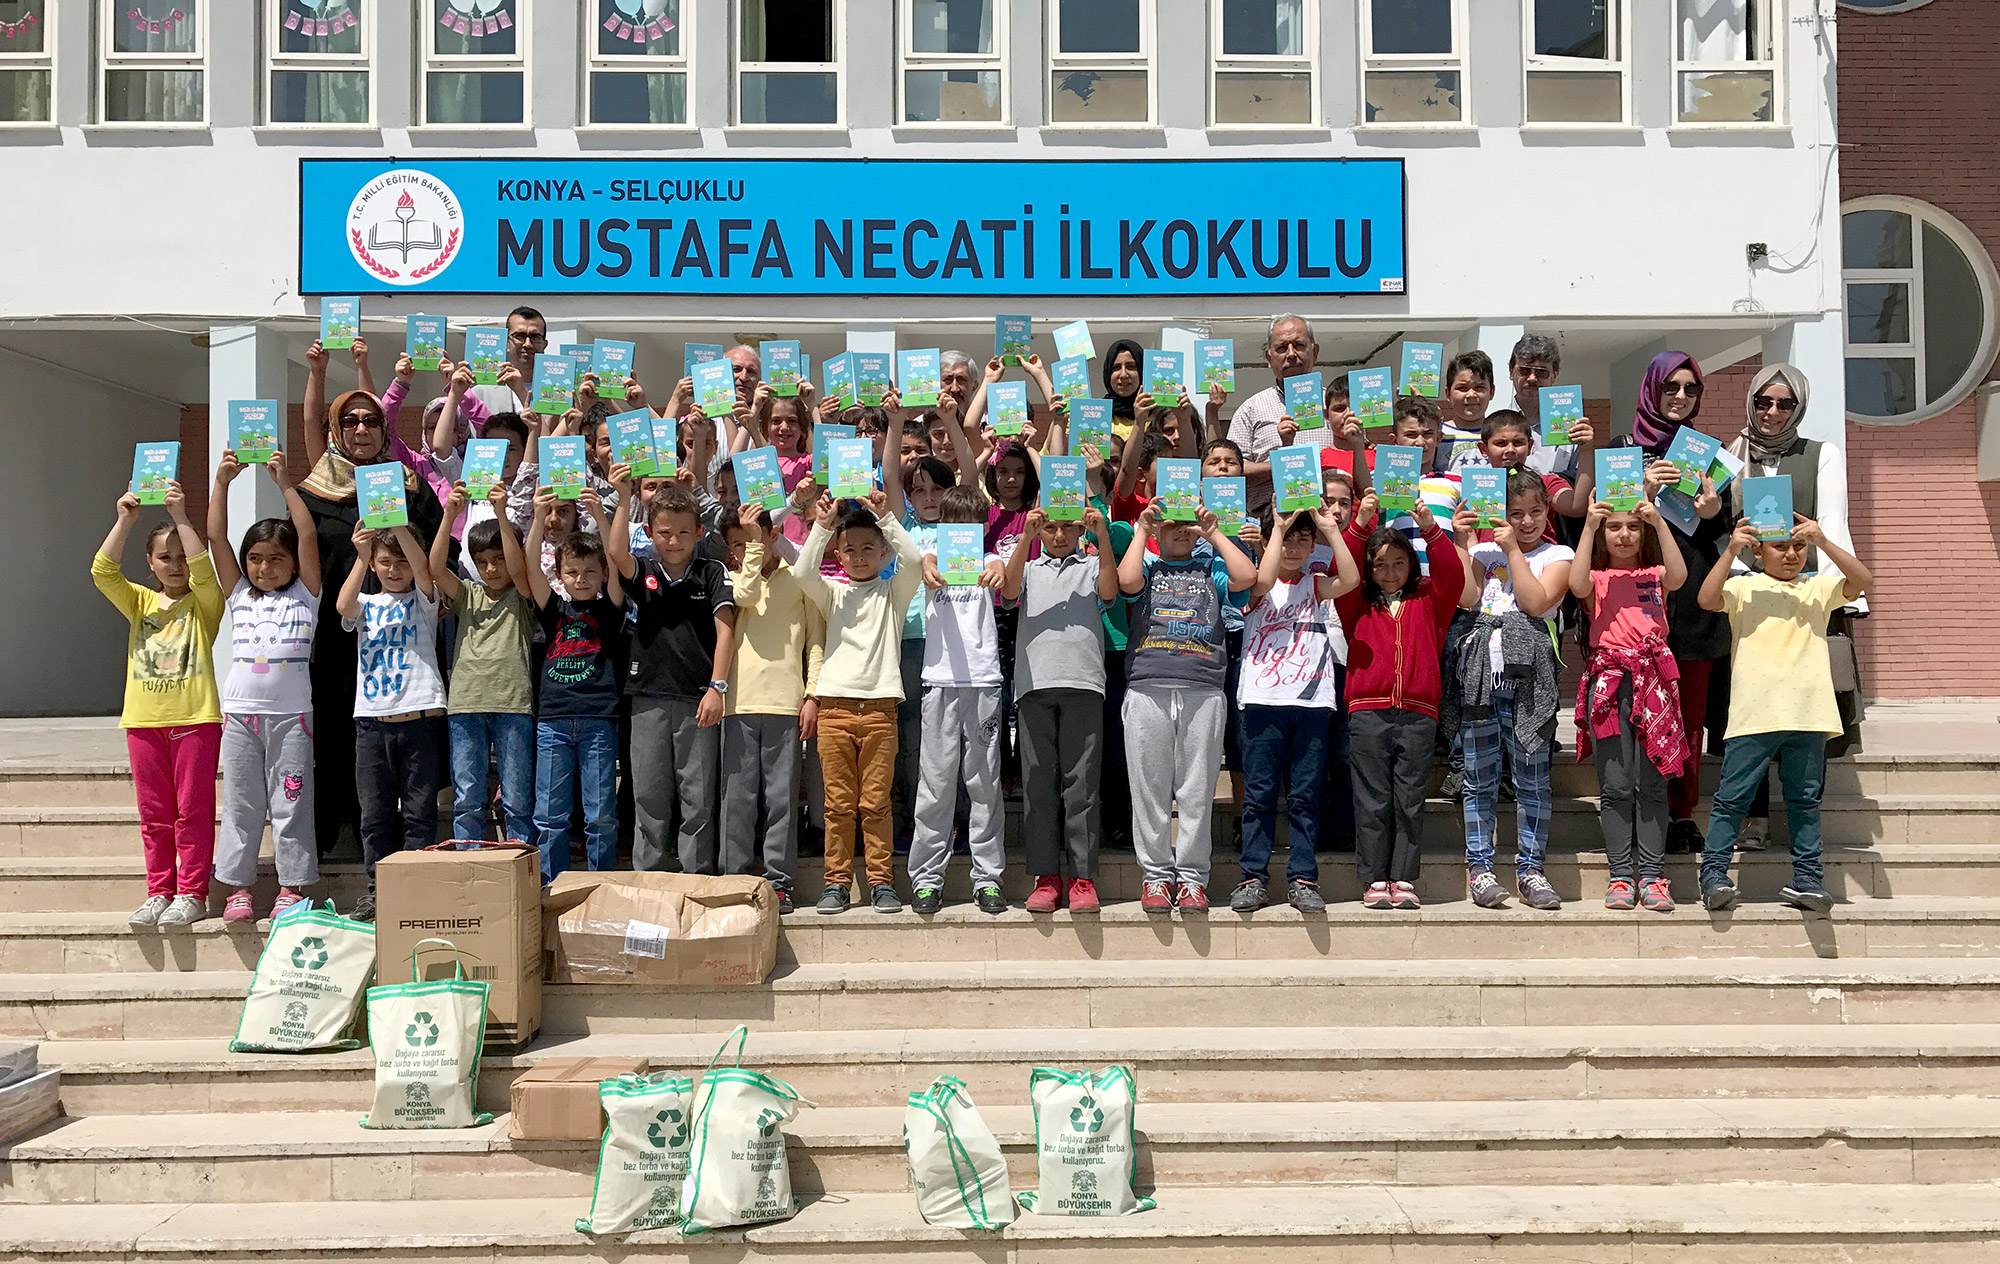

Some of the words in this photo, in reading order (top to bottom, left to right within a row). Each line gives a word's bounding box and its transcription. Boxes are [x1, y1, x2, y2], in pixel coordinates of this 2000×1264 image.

[352, 203, 366, 220] T.C.
[362, 179, 385, 202] MİLLİ
[386, 174, 419, 186] EĞİTİM
[420, 178, 457, 220] BAKANLIĞI
[498, 179, 586, 201] KONYA
[610, 179, 744, 205] SELÇUKLU
[497, 217, 794, 278] MUSTAFA
[814, 204, 1034, 280] NECATİ
[1059, 204, 1372, 280] İLKOKULU
[364, 598, 415, 626] STAY
[1166, 620, 1214, 643] 1976
[1246, 623, 1310, 671] High
[360, 647, 413, 674] SAIL
[1255, 653, 1332, 689] School
[363, 673, 403, 700] ON
[304, 972, 331, 982] zararsız
[324, 984, 342, 993] torba
[282, 1021, 305, 1029] KONYA
[269, 1026, 316, 1040] BÜYÜKŞEHİR
[395, 1049, 420, 1059] Doğaya
[420, 1049, 446, 1057] zararsız
[380, 1060, 392, 1068] bez
[394, 1059, 411, 1068] torba
[422, 1058, 440, 1068] kağıt
[440, 1058, 459, 1066] torba
[394, 1107, 446, 1116] BÜYÜKŞEHİR
[1060, 1134, 1083, 1144] Doğaya
[1084, 1134, 1110, 1144] zararsız
[1044, 1143, 1056, 1152] bez
[1058, 1144, 1076, 1154] torba
[1087, 1145, 1104, 1155] kağıt
[1106, 1144, 1125, 1152] torba
[640, 1151, 666, 1162] Doğaya
[668, 1151, 689, 1159] zarars
[731, 1150, 744, 1160] bez
[624, 1161, 637, 1170] bez
[639, 1162, 659, 1170] torba
[671, 1160, 689, 1172] kağıt
[1062, 1156, 1106, 1166] kullanıyoruz.
[1071, 1192, 1098, 1200] KONYA
[755, 1200, 777, 1208] KONYA
[1057, 1198, 1112, 1210] BÜYÜKŞEHİR
[648, 1208, 675, 1216] KONYA
